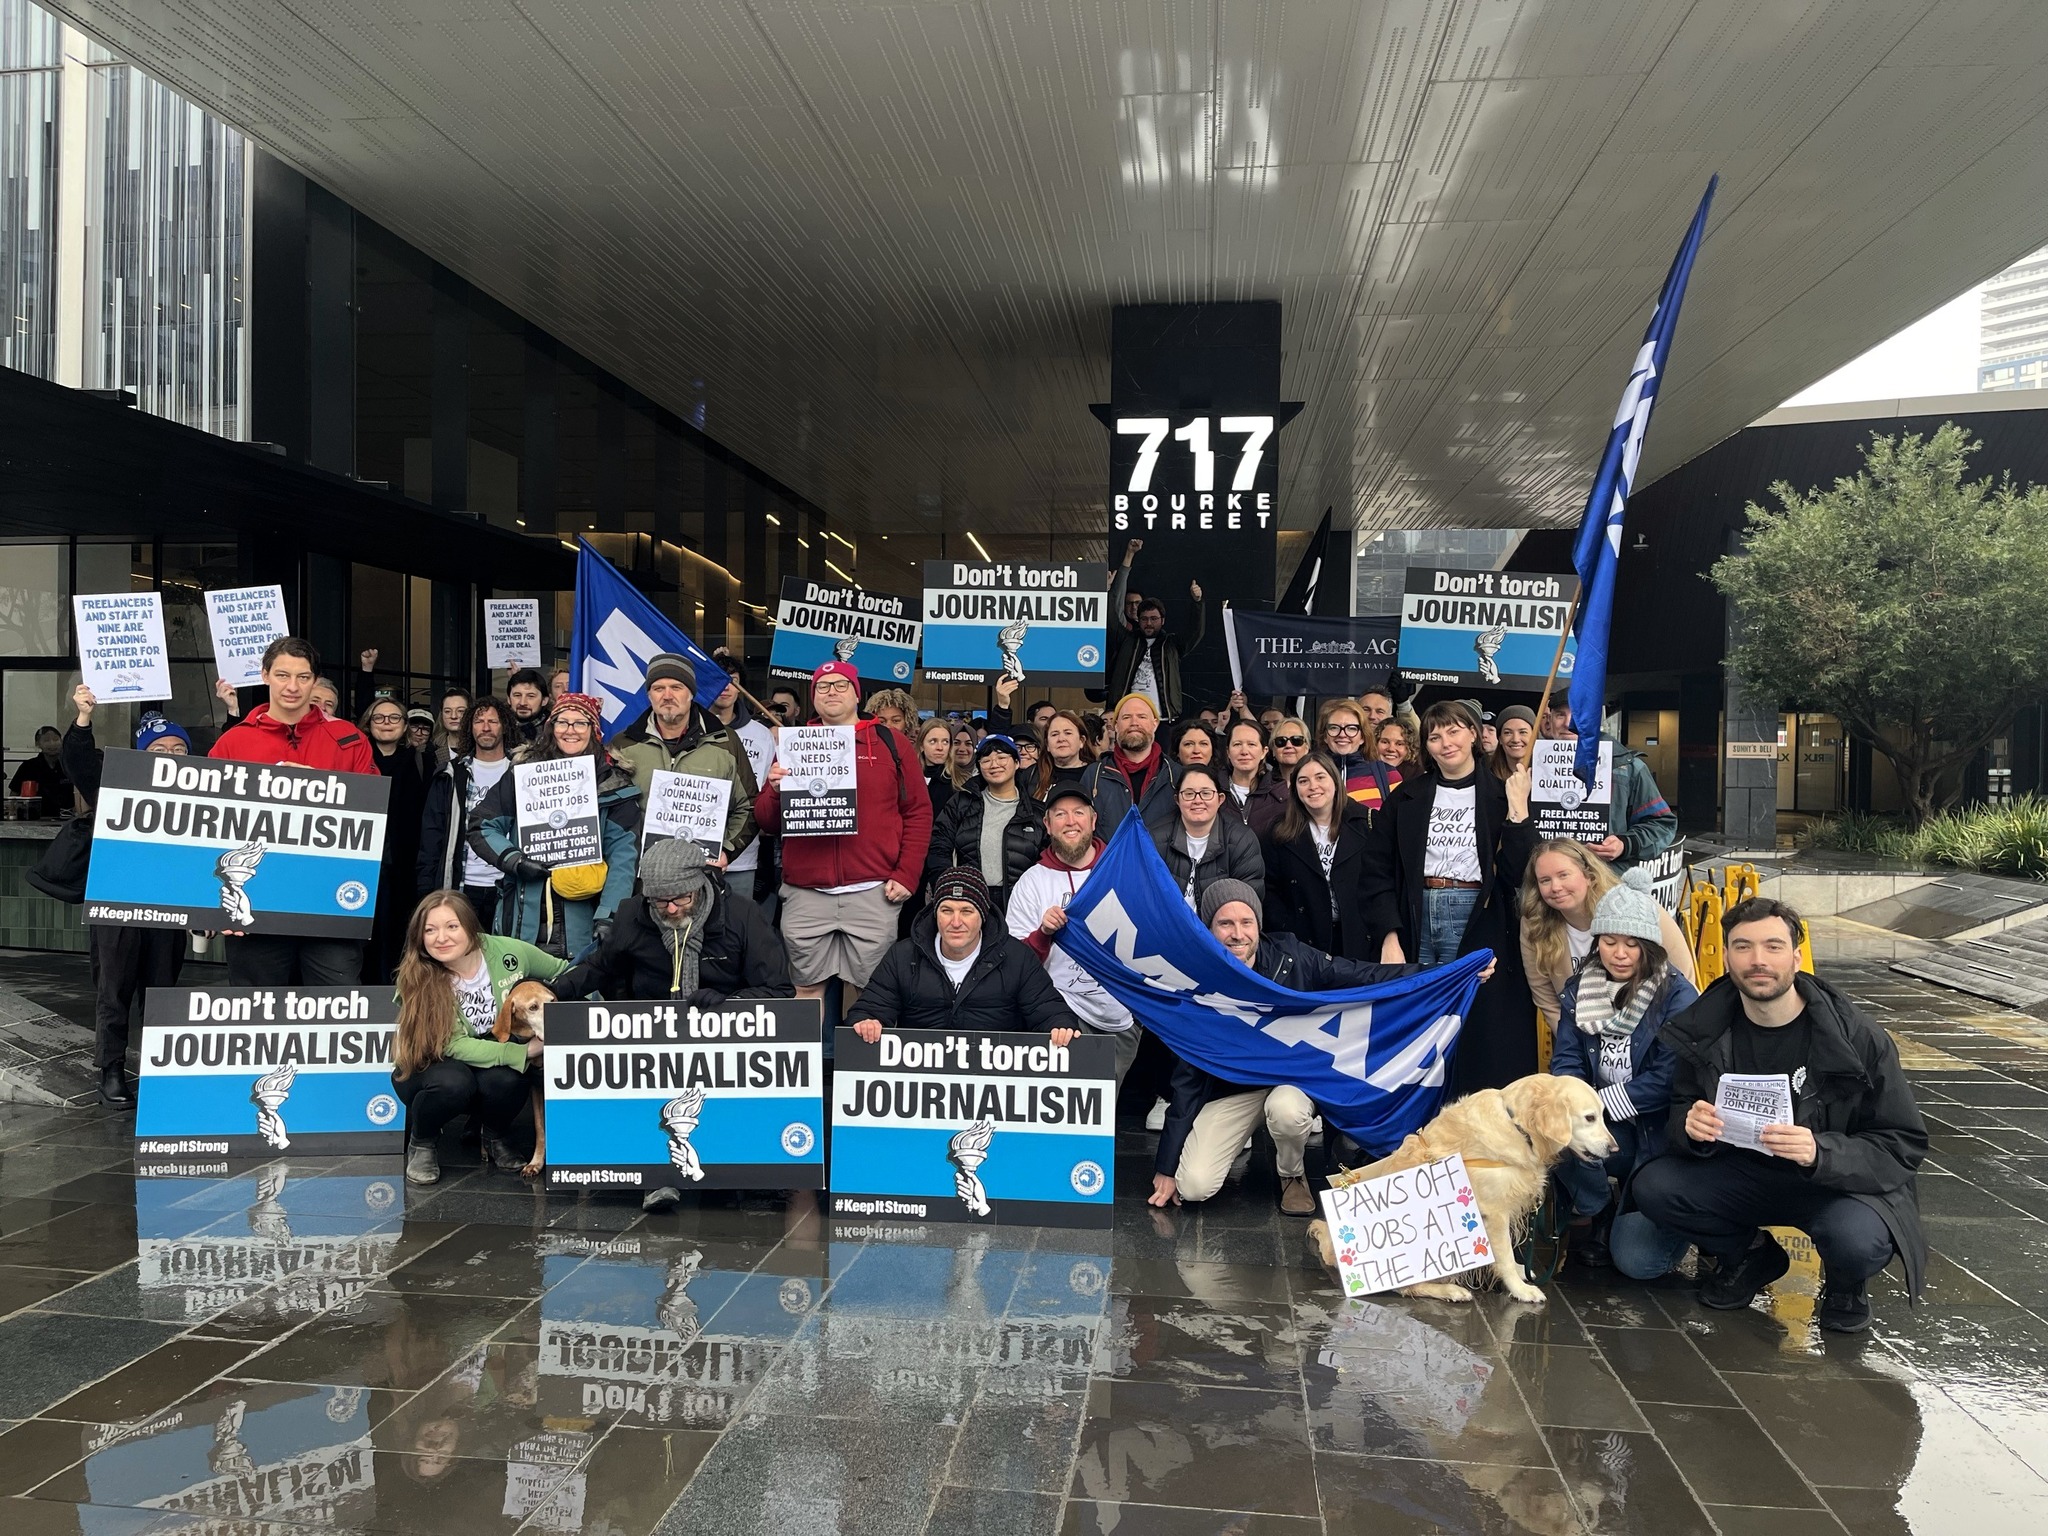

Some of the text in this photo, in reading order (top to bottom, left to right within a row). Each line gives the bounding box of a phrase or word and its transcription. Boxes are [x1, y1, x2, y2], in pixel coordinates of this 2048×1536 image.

[1117, 416, 1274, 492] 717
[1115, 493, 1270, 512] BOURKE
[1115, 512, 1271, 530] STREET
[953, 563, 1078, 588] Don't torch
[1434, 571, 1560, 598] Don't torch
[82, 597, 154, 609] FREELANCERS
[212, 589, 276, 603] FREELANCERS
[805, 582, 903, 616] Don't torch
[217, 600, 276, 614] AND STAFF AT
[929, 594, 1099, 622] JOURNALISM
[85, 610, 154, 622] AND STAFF AT
[228, 612, 269, 624] NINE ARE
[97, 622, 144, 633] NINE ARE
[228, 622, 273, 635] STANDING
[782, 606, 915, 644] JOURNALISM
[97, 634, 147, 646] STANDING
[219, 634, 265, 648] TOGETHER
[1255, 637, 1399, 655] THE AG
[86, 645, 160, 659] TOGETHER FOR
[228, 649, 234, 658] A
[236, 647, 256, 657] FAIR
[95, 658, 155, 670] A FAIR DEAL
[771, 668, 813, 681] #KeepItStro
[925, 671, 985, 682] #KeepItStrong
[1400, 671, 1459, 684] #KeepItStrong
[798, 728, 835, 739] QUALITY
[789, 741, 846, 751] JOURNALISM
[1553, 743, 1577, 752] QUAL
[1732, 744, 1772, 753] SUNNY'S DELI
[801, 754, 832, 764] NEEDS
[535, 760, 574, 773] QUALITY
[787, 766, 849, 777] QUALITY JOBS
[1554, 767, 1573, 777] NEE
[151, 757, 347, 805] Don't torch
[527, 770, 585, 787] JOURNALISM
[673, 777, 711, 790] QUALITY
[1539, 779, 1604, 790] QUALITY JBS
[539, 785, 571, 797] NEEDS
[662, 788, 718, 803] JOURNALISM
[525, 794, 589, 812] QUALITY JOBS
[672, 801, 702, 813] NEEDS
[790, 797, 848, 808] FREELANCERS
[656, 812, 717, 828] QUALITY JOBS
[783, 808, 855, 819] CARRY THE TORCH
[1540, 809, 1600, 820] FREELANCERS
[105, 797, 374, 852] JOURNALISM
[786, 819, 853, 830] WITH NINE STAFF!
[1562, 820, 1578, 830] THE
[1579, 821, 1608, 831] TORCH
[530, 825, 589, 842] FREELANCERS
[1539, 831, 1554, 840] ITH
[1576, 833, 1604, 842] STAFF!
[523, 835, 598, 854] CARRY THE TORCH
[547, 850, 567, 862] NINE
[568, 847, 596, 859] STAFF!
[88, 906, 189, 925] #KeepItStrong
[498, 971, 524, 988] CHAMPS
[188, 990, 369, 1021] Don't torch
[588, 1005, 776, 1040] Don't torch
[151, 1031, 394, 1067] JOURNALISM
[879, 1033, 1070, 1073] Don't torch
[554, 1051, 810, 1090] JOURNALISM
[842, 1079, 1102, 1126] JOURNALISM
[1725, 1091, 1778, 1107] ON STRIKE
[1723, 1099, 1777, 1116] JOIN MEAA
[140, 1141, 229, 1154] #KeepItStrong
[552, 1170, 642, 1185] #KeepItStrong
[1331, 1156, 1460, 1221] PAWS OFF
[835, 1199, 927, 1217] #KeepItStrong
[1355, 1201, 1456, 1253] JOBS AT
[1353, 1236, 1476, 1291] THE AGE
